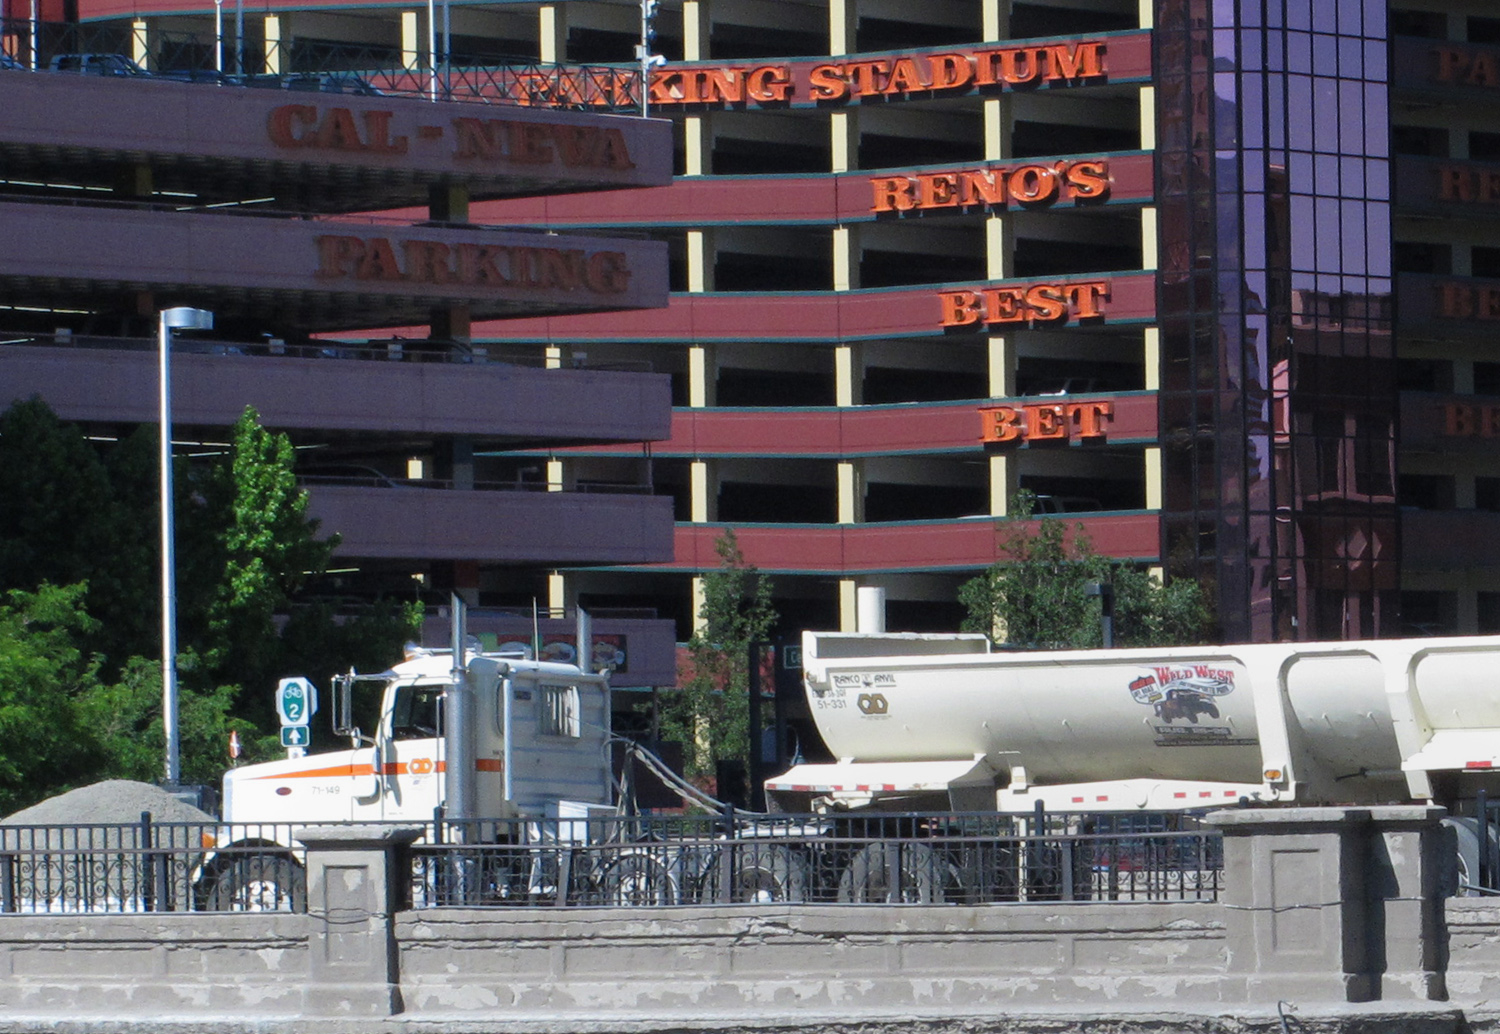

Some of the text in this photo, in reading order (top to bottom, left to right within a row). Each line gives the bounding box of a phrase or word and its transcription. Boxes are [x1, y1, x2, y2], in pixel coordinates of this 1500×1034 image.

[809, 43, 1105, 100] STADIUM
[870, 160, 1109, 213] RENO'S
[314, 234, 632, 294] PARKING
[937, 281, 1108, 327] BEST
[977, 401, 1110, 443] BET
[289, 703, 299, 718] 2
